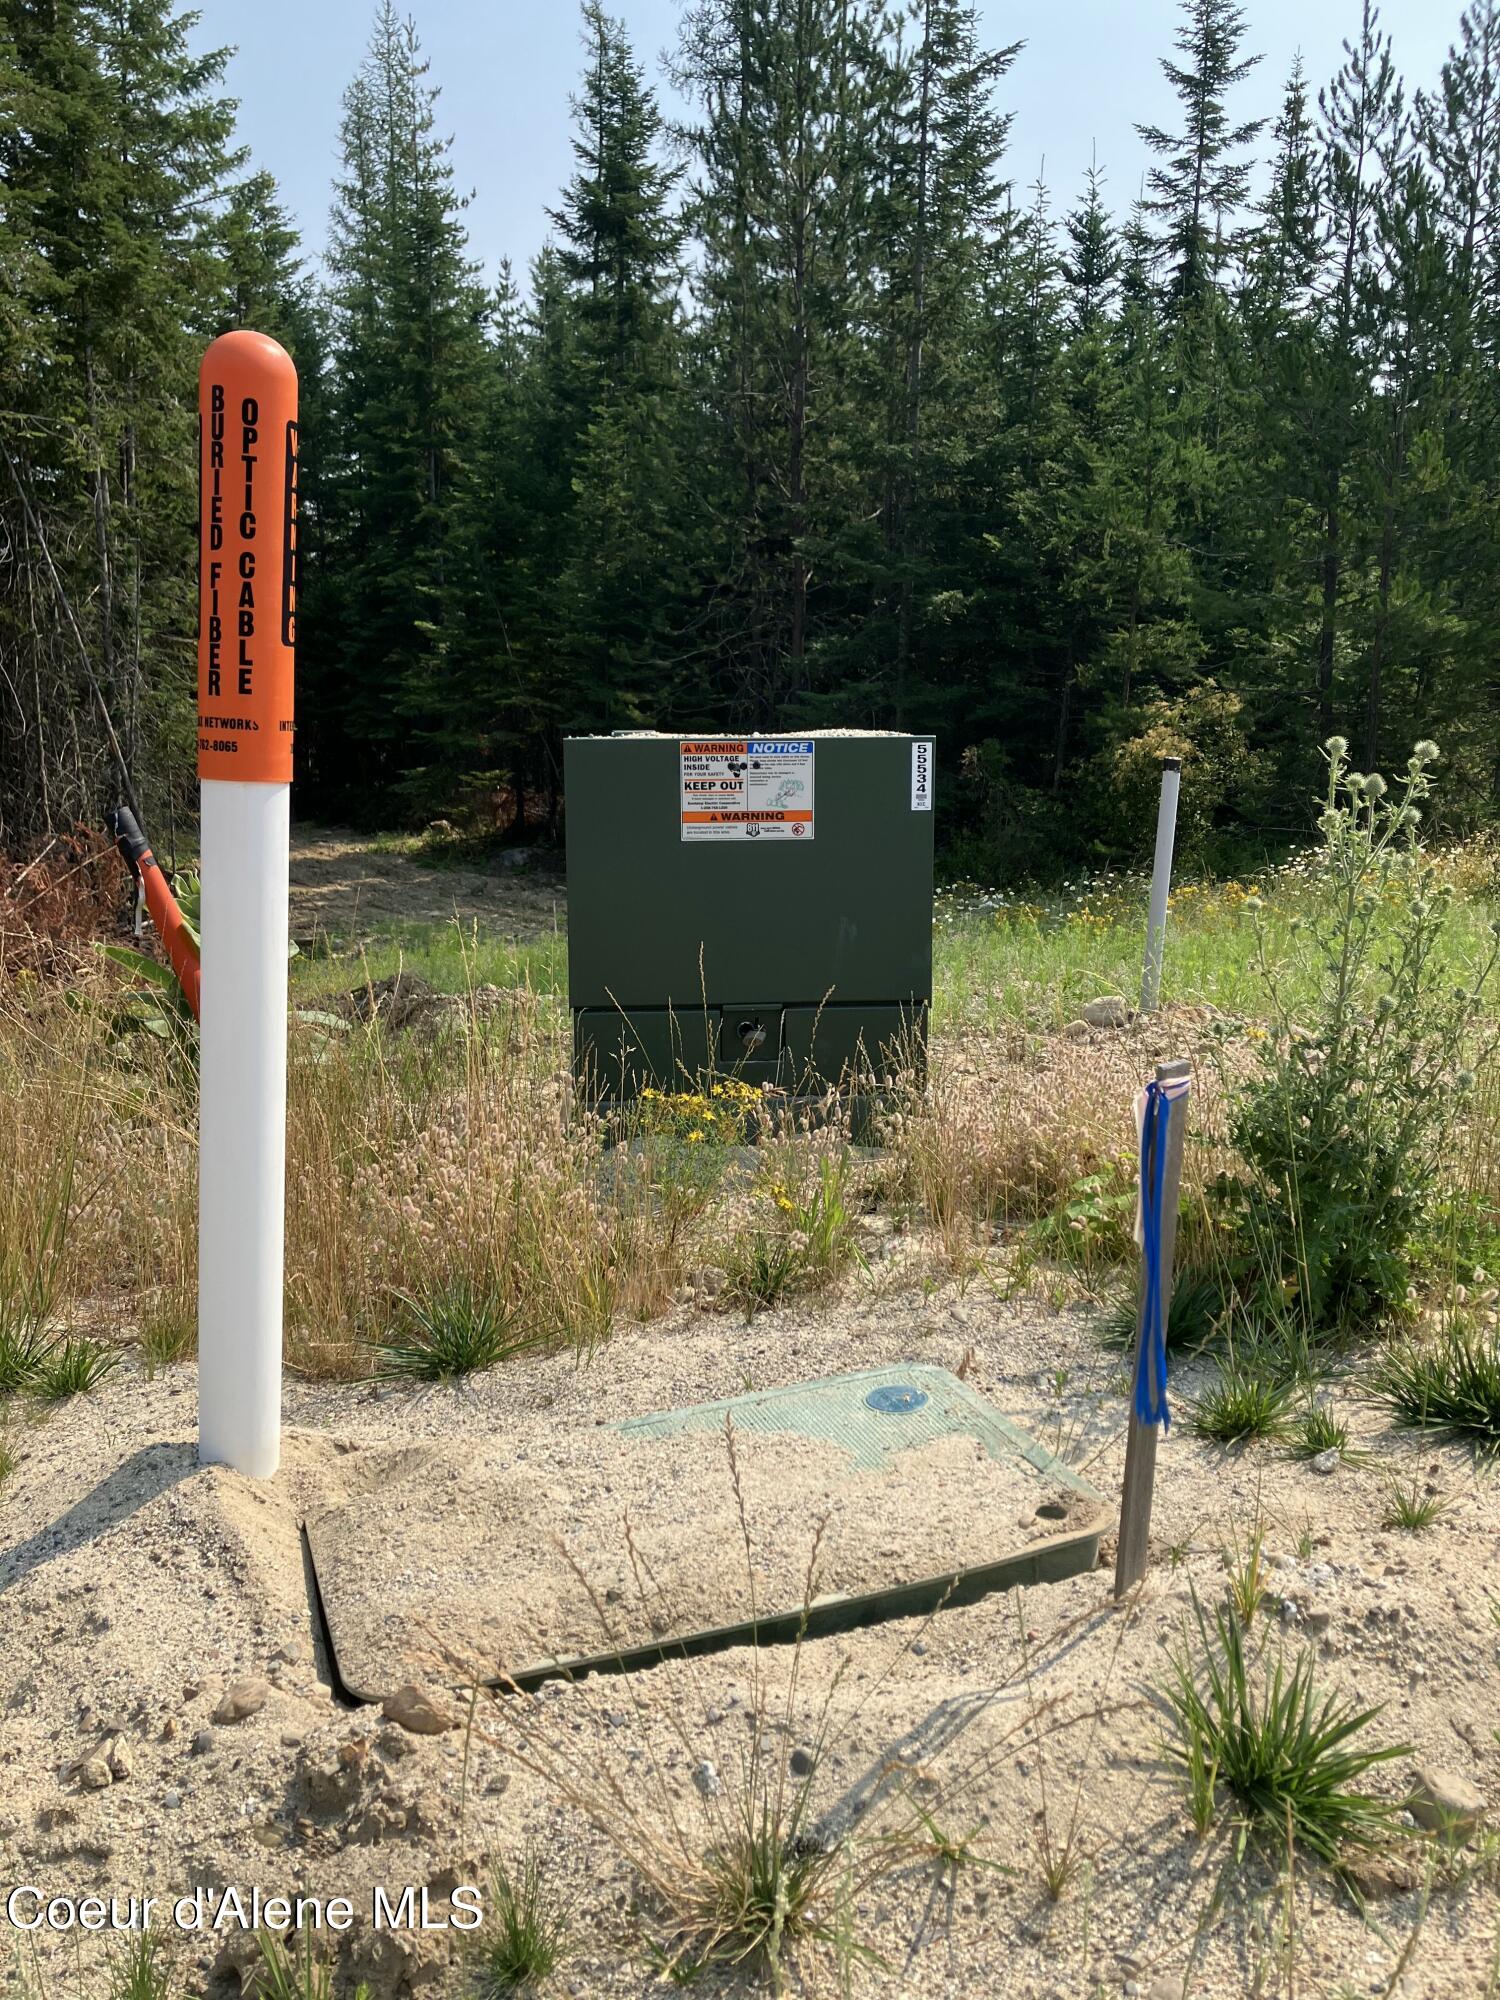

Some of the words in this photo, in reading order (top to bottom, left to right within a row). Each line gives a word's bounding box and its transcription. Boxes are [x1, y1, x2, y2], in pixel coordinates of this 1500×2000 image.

[210, 385, 224, 551] BURIED
[239, 398, 258, 539] OPTIC
[208, 562, 222, 697] FIBER
[238, 551, 256, 695] CABLE
[204, 716, 260, 731] NETWORKS
[695, 744, 743, 752] WARNING
[753, 743, 808, 753] NOTICE
[916, 744, 927, 793] 55534
[684, 781, 716, 791] KEEP
[720, 781, 744, 790] OUT
[721, 812, 784, 820] WARNING
